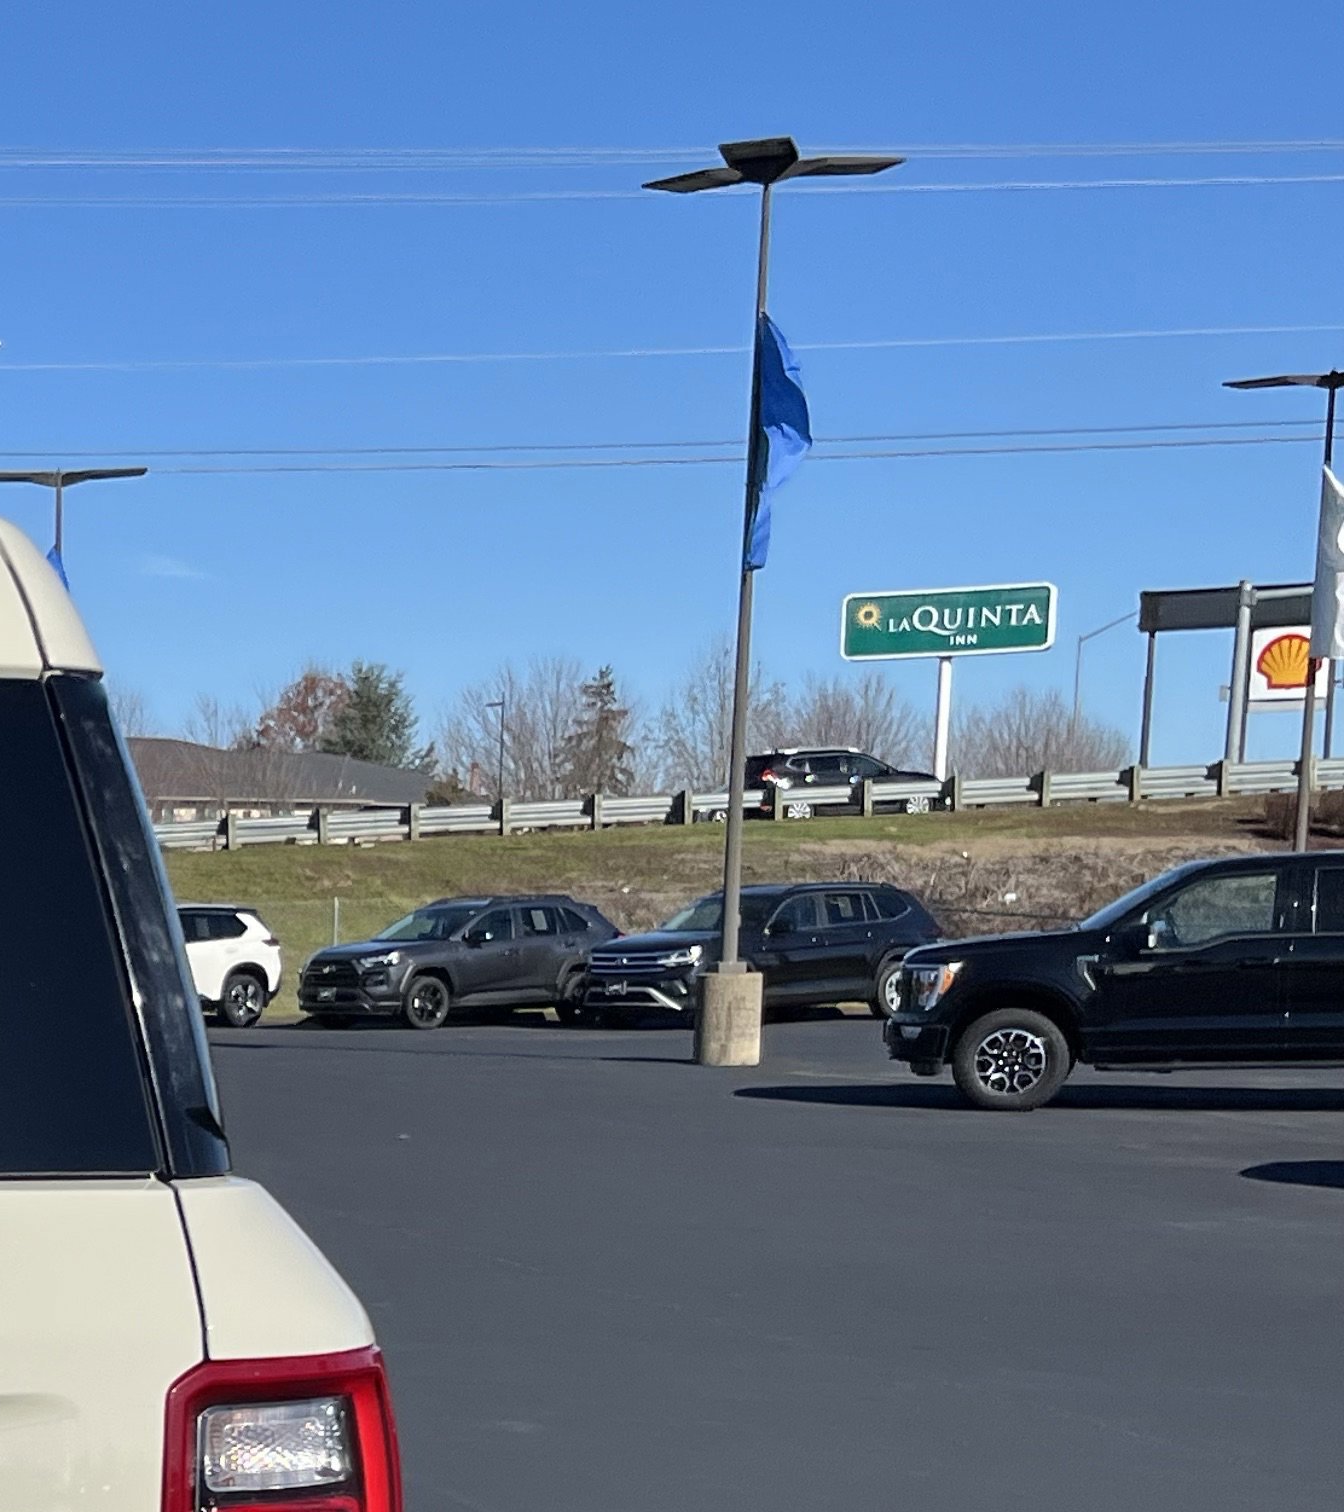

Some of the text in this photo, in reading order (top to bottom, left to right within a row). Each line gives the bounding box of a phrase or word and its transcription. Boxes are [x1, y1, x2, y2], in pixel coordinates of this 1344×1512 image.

[888, 603, 1043, 636] LA QUINTA
[949, 634, 978, 646] INN
